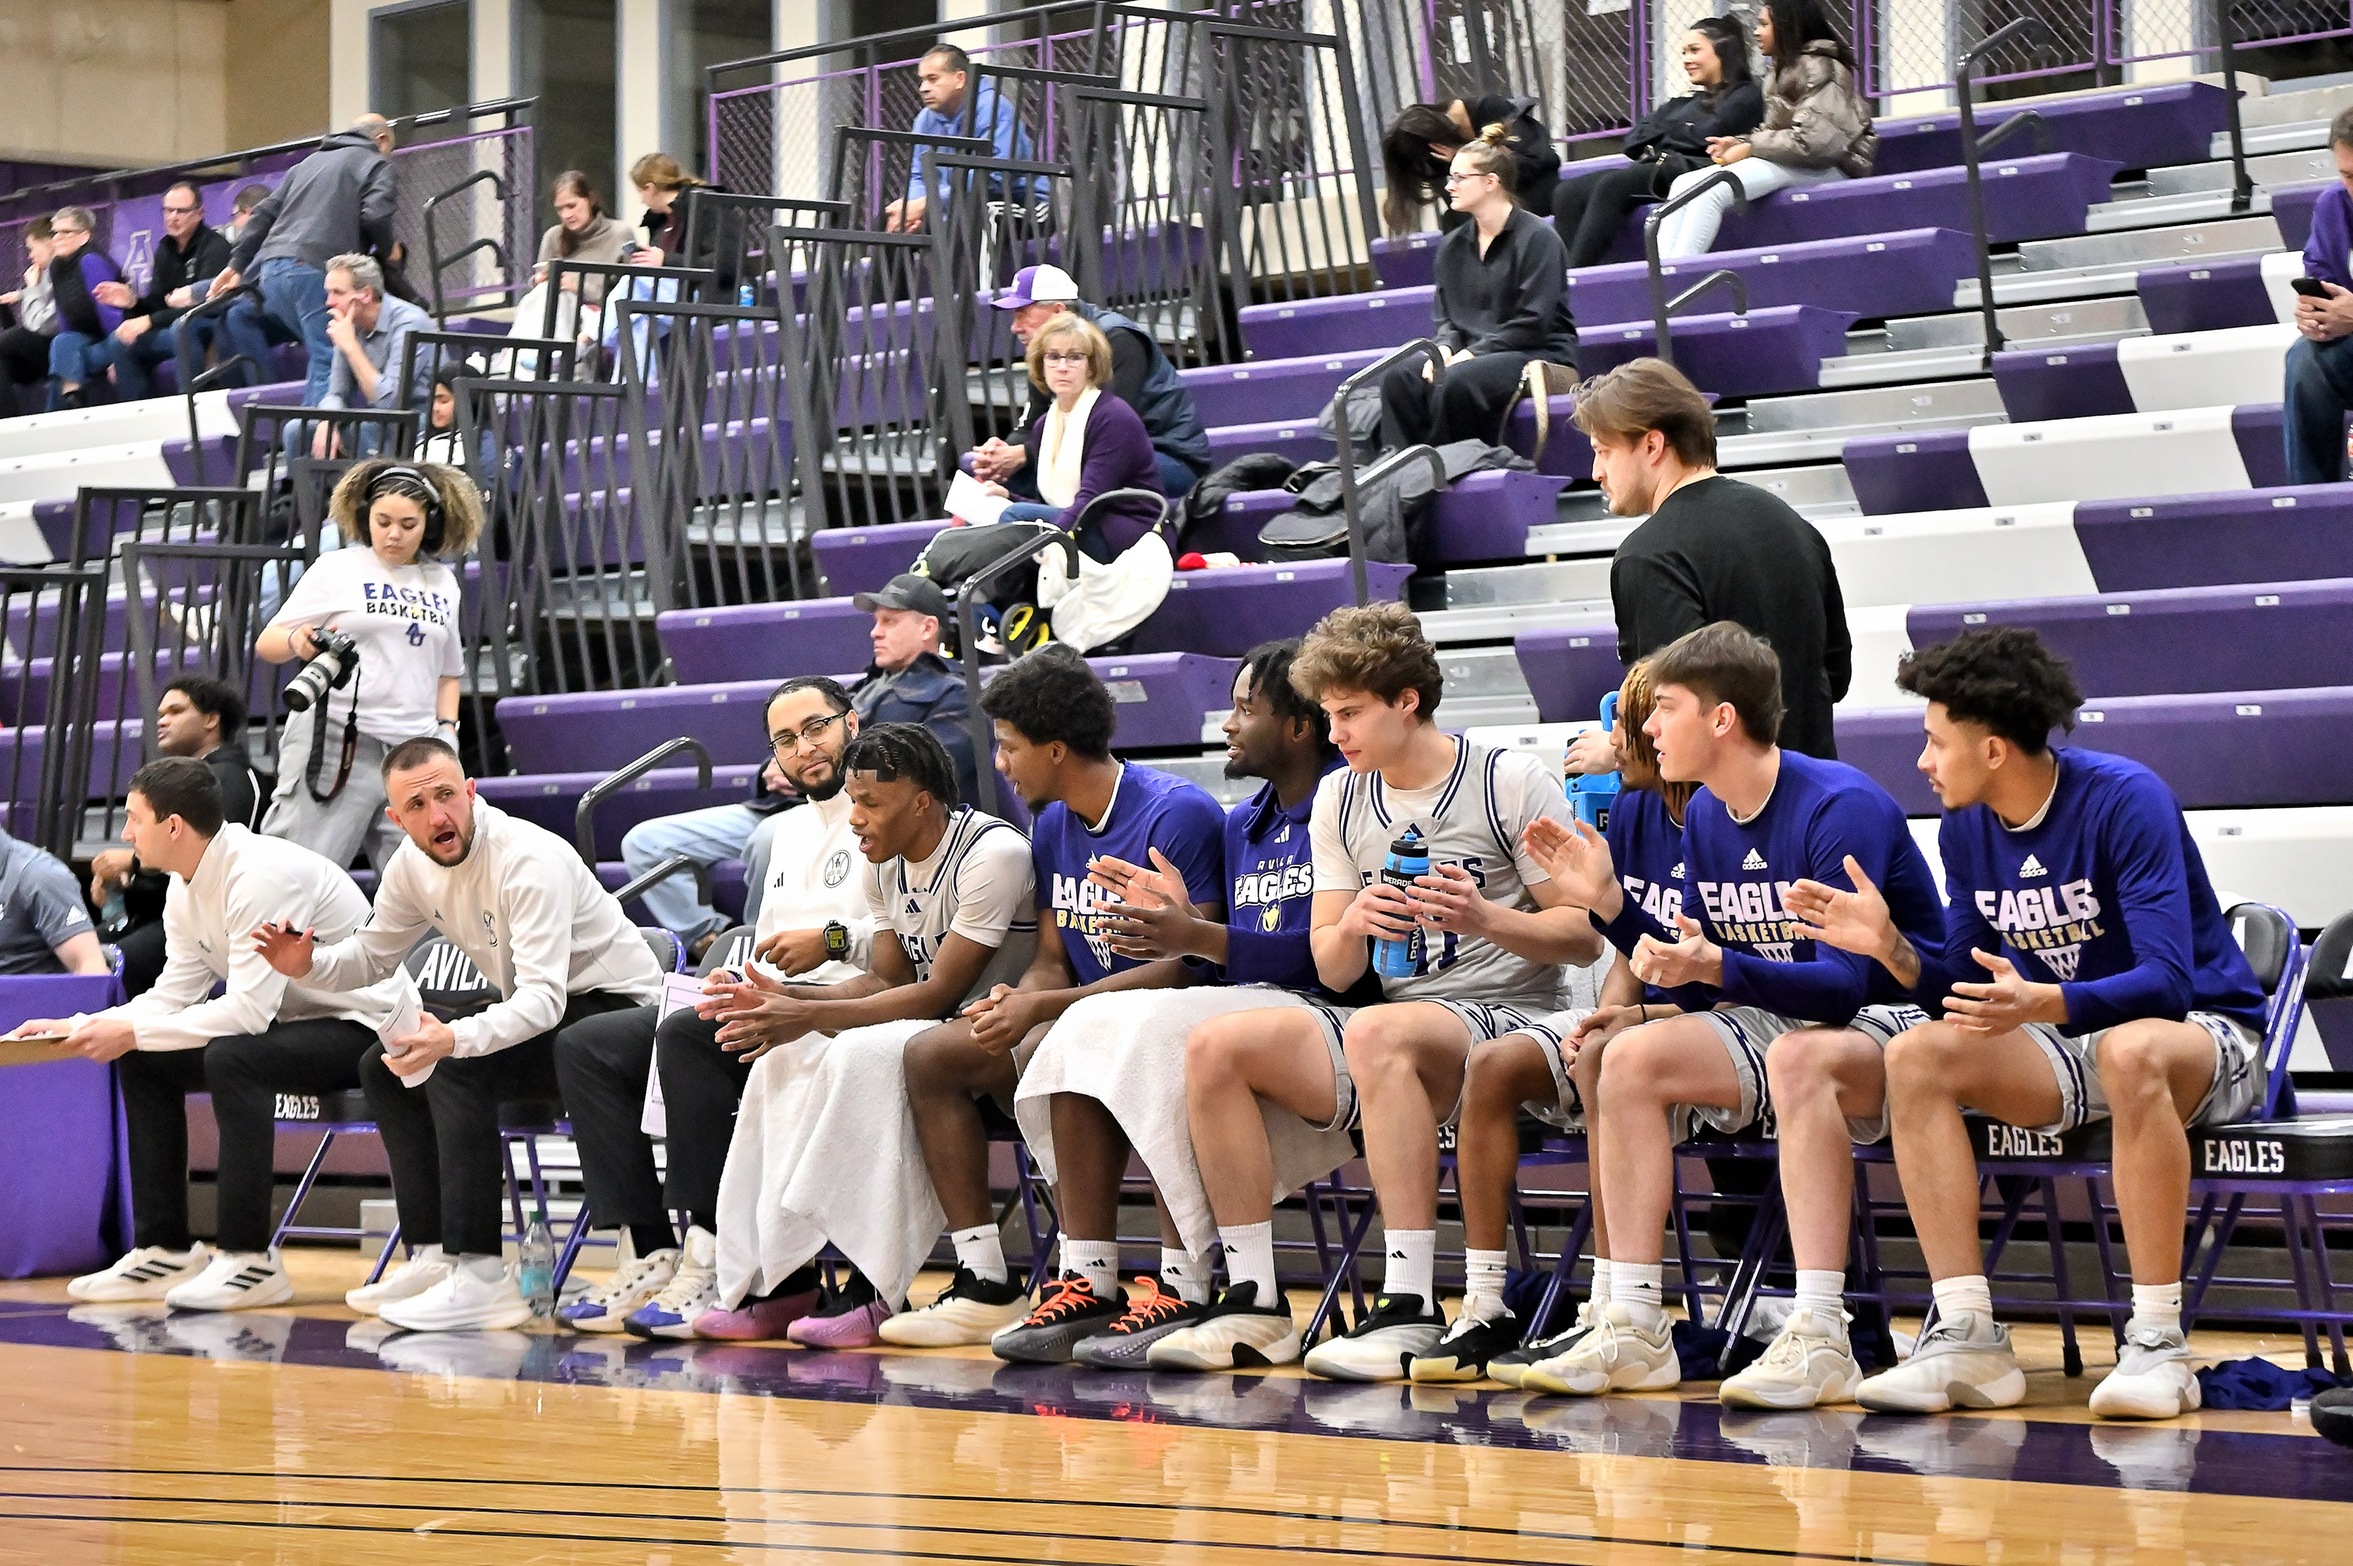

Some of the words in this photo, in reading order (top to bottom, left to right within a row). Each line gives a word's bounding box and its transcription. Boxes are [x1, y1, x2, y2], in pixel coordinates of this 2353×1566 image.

[1235, 862, 1313, 910] EAGLES
[274, 1093, 320, 1119] EAGLES
[1988, 1125, 2063, 1156] EAGLES
[2204, 1139, 2285, 1173] EAGLES
